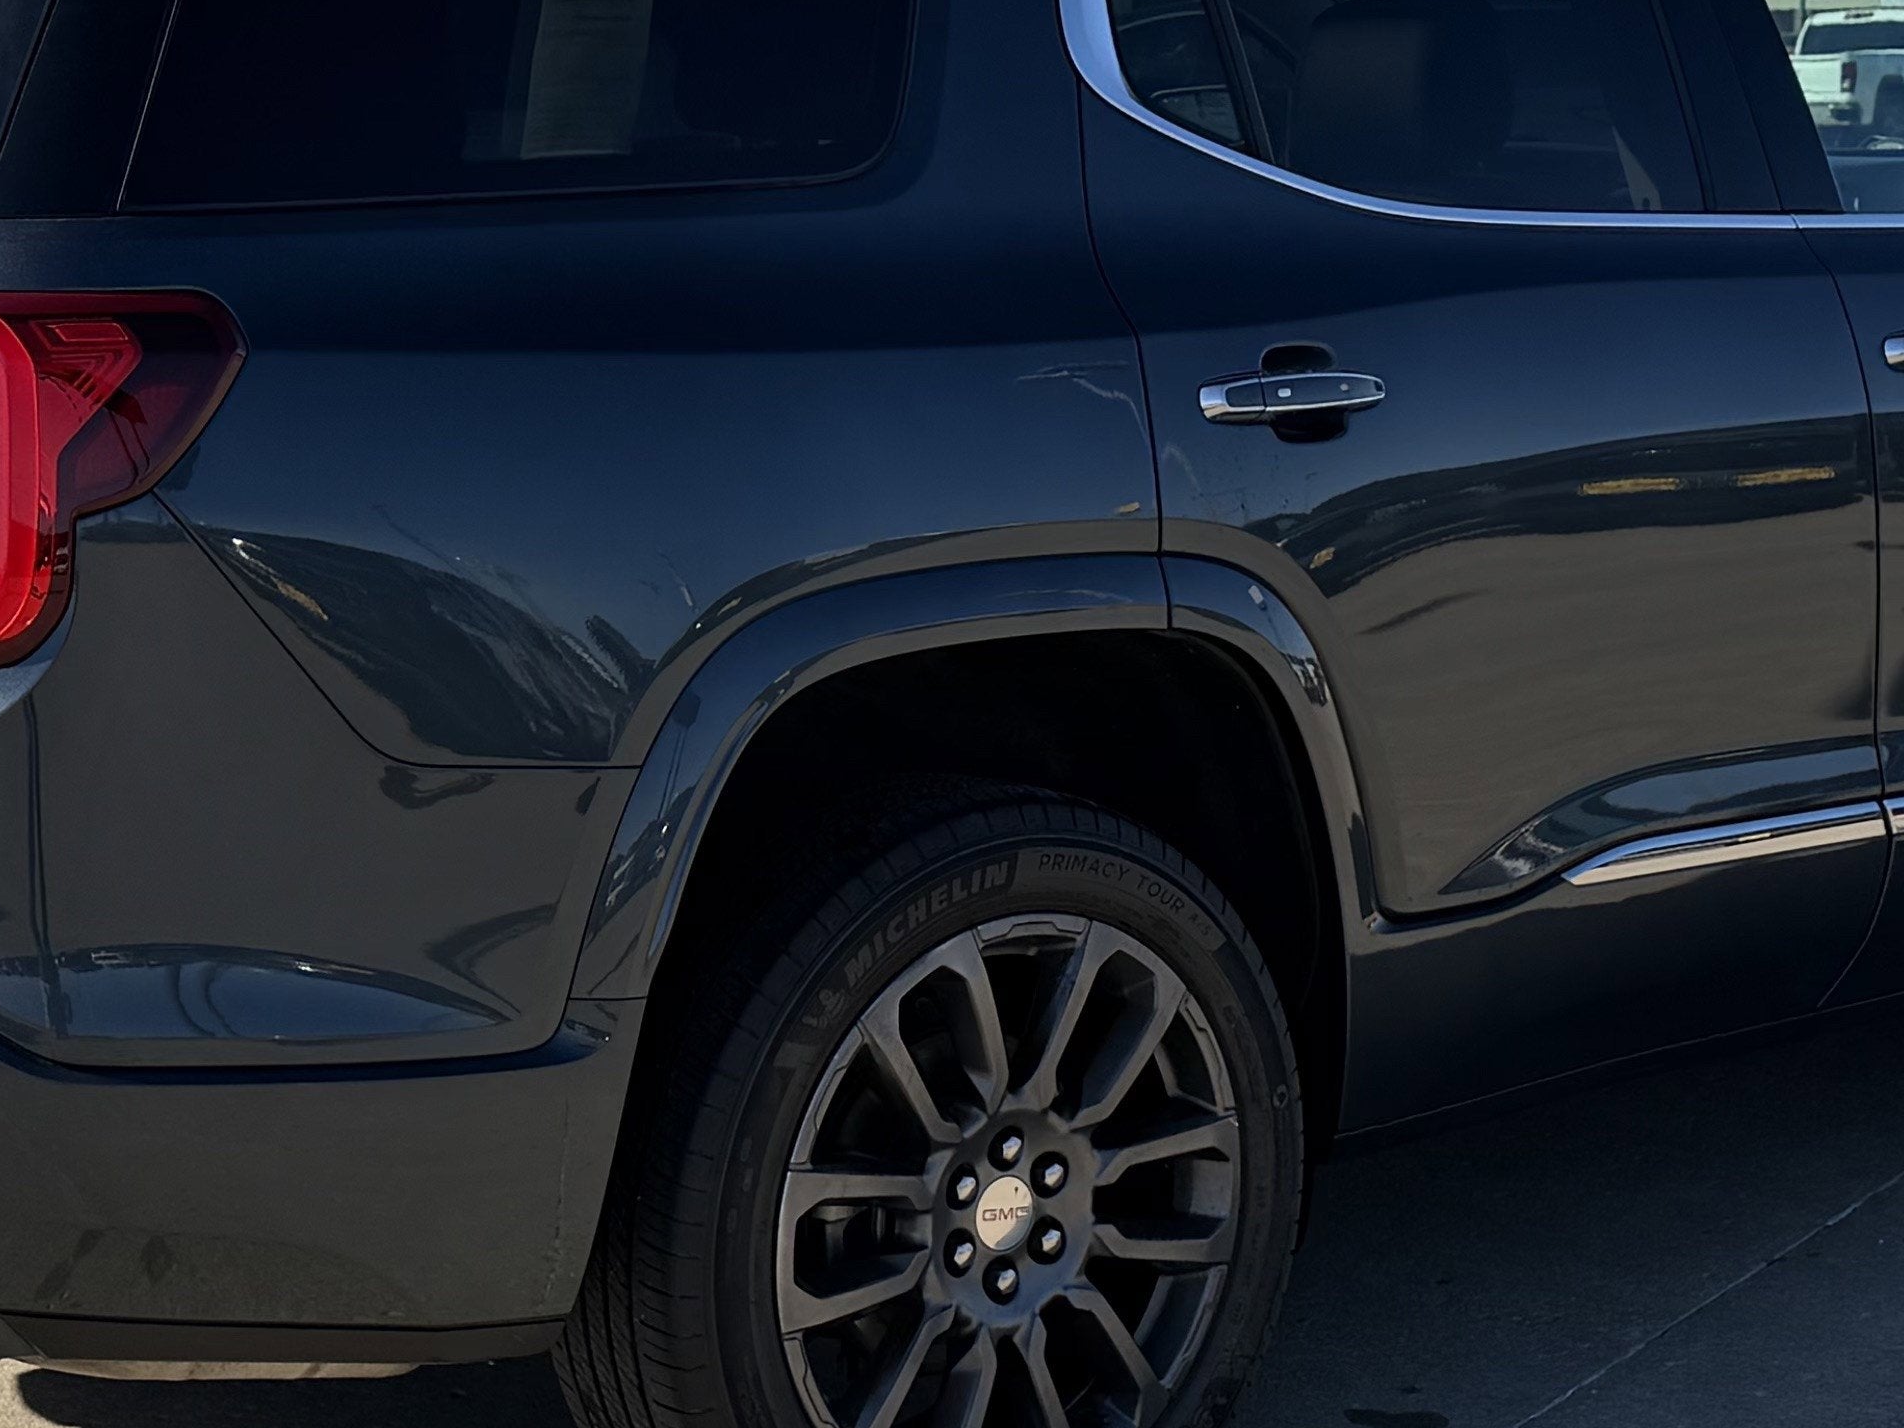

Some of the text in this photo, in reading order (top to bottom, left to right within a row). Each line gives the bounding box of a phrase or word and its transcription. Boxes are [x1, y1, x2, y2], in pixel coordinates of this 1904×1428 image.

[1039, 853, 1130, 882] PRIMACY
[1137, 874, 1186, 914] TOUR
[844, 861, 1008, 988] MICHELIN
[982, 1205, 1030, 1222] GMC
